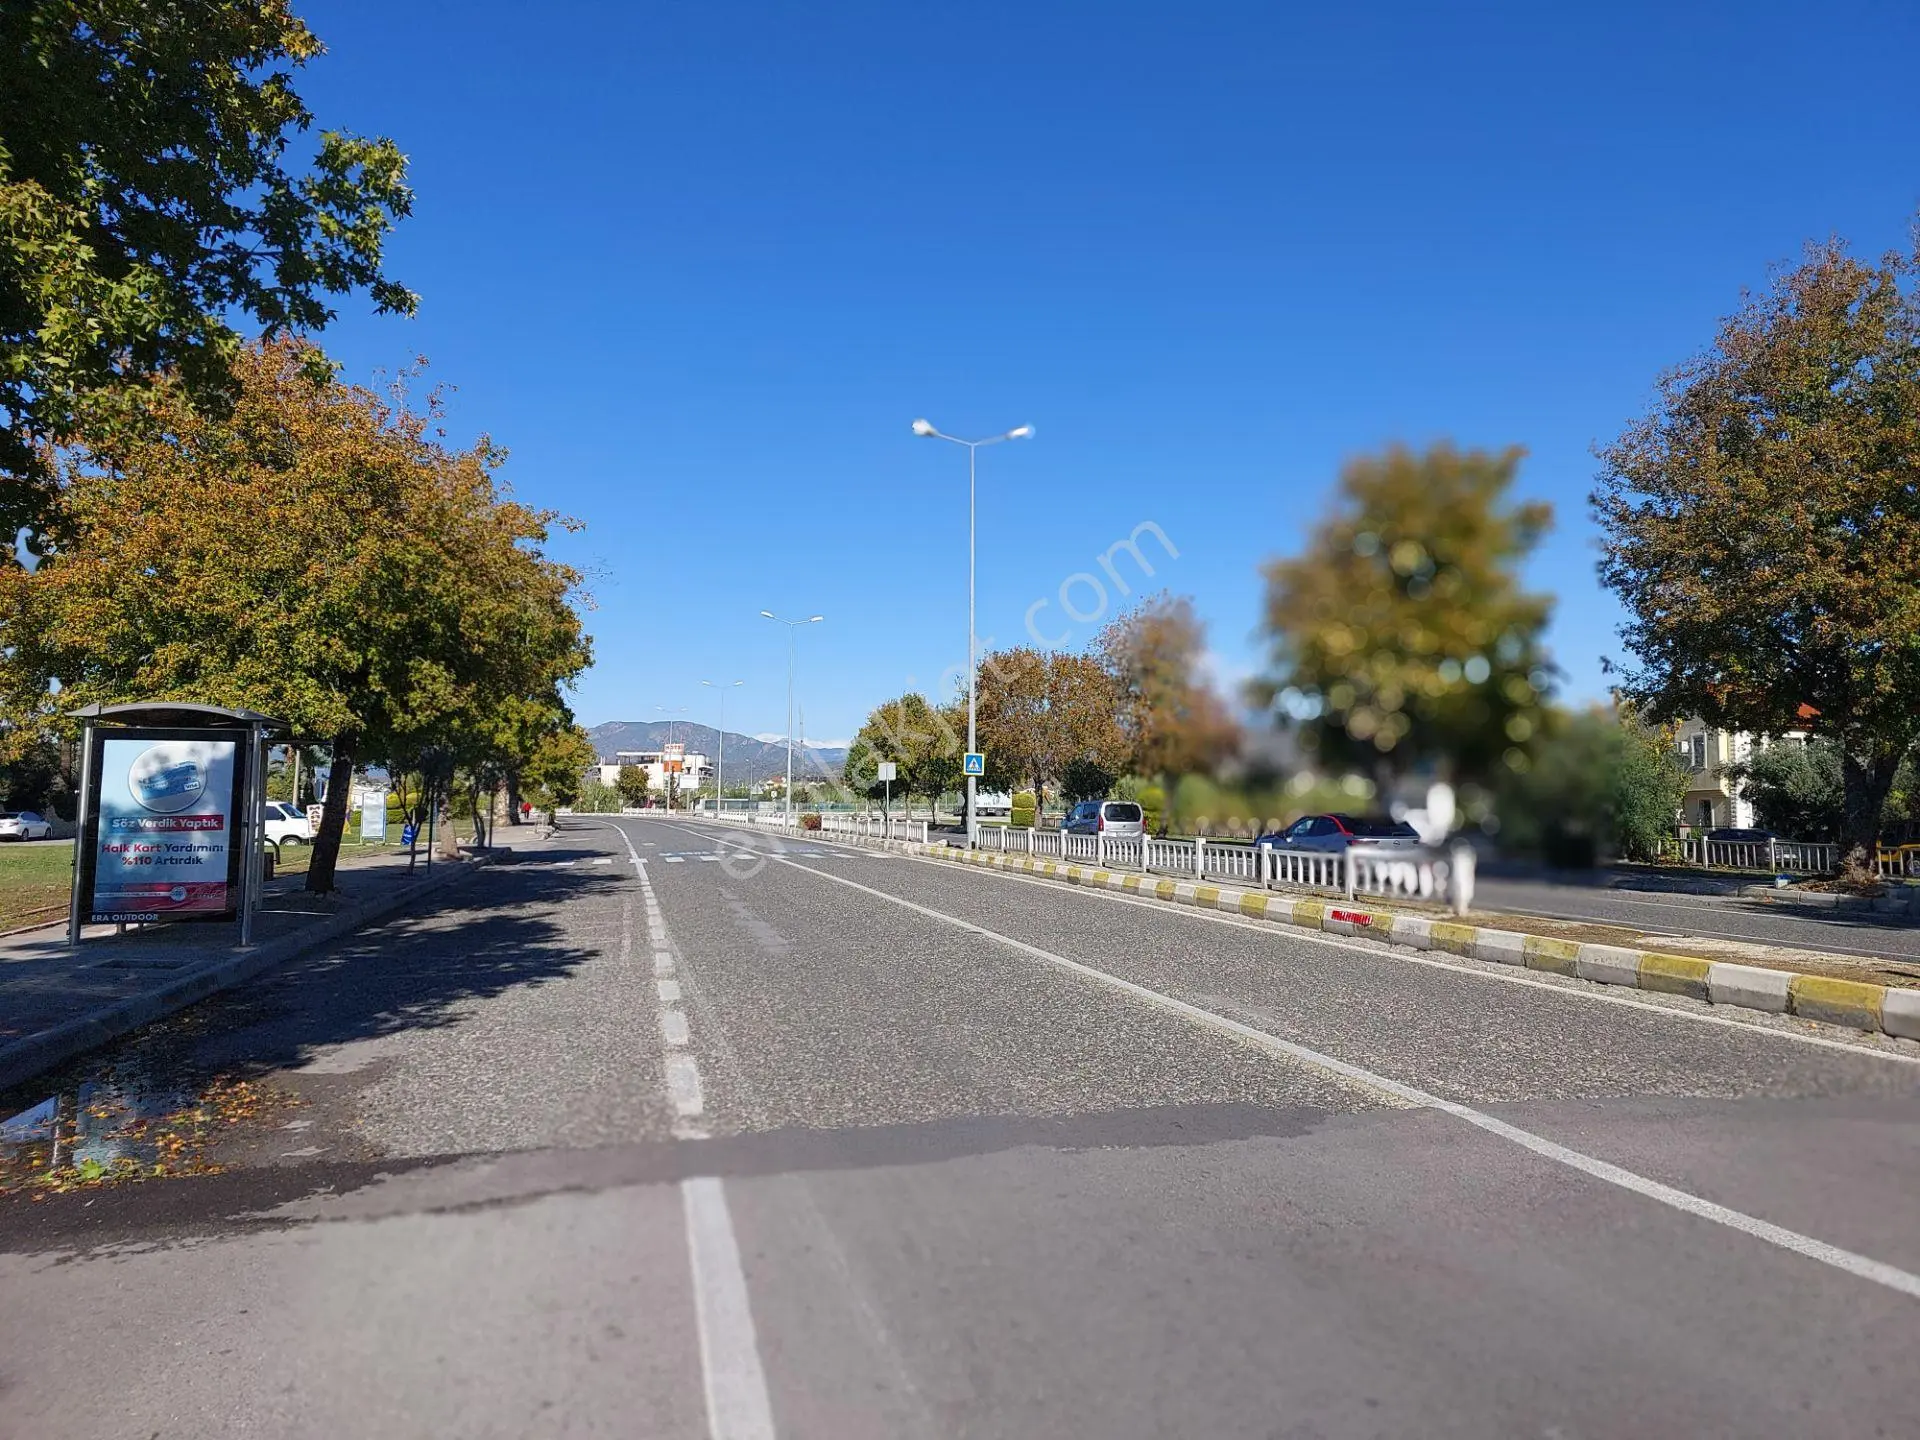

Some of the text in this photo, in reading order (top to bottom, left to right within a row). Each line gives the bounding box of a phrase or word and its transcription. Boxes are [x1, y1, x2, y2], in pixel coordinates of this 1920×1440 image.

[112, 817, 218, 829] Söz Verdik Yaptık
[102, 843, 223, 853] Halk Kart Yardımını
[155, 856, 203, 865] Artırdık
[91, 913, 159, 922] ERA OUTDOOR
